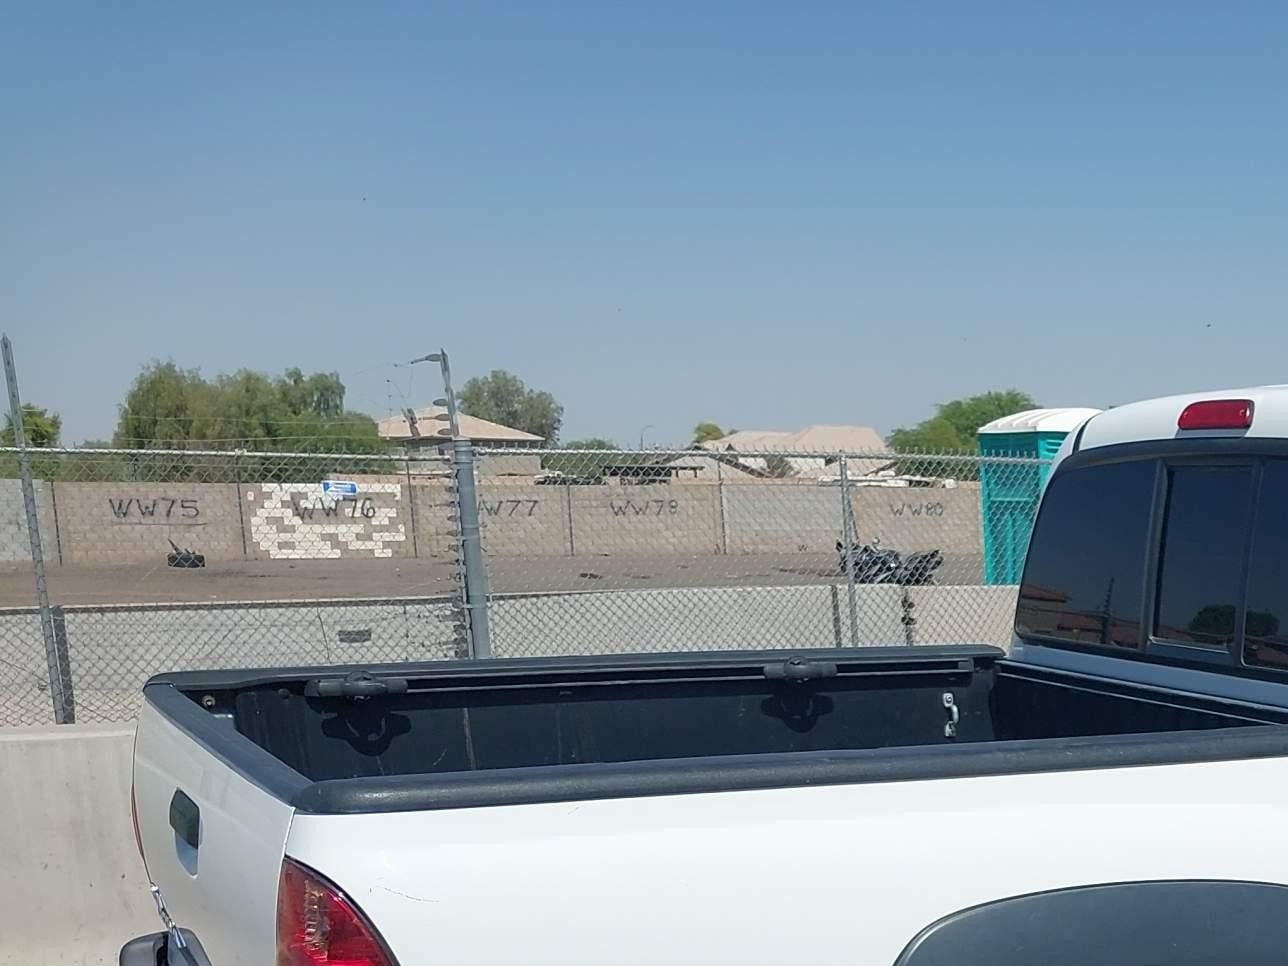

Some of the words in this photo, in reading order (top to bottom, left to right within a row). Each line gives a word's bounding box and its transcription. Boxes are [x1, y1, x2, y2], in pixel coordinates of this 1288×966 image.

[108, 497, 200, 518] WW75
[290, 497, 376, 519] WW76
[477, 499, 539, 517] W77
[609, 499, 679, 516] WW78
[889, 501, 944, 517] WW80
